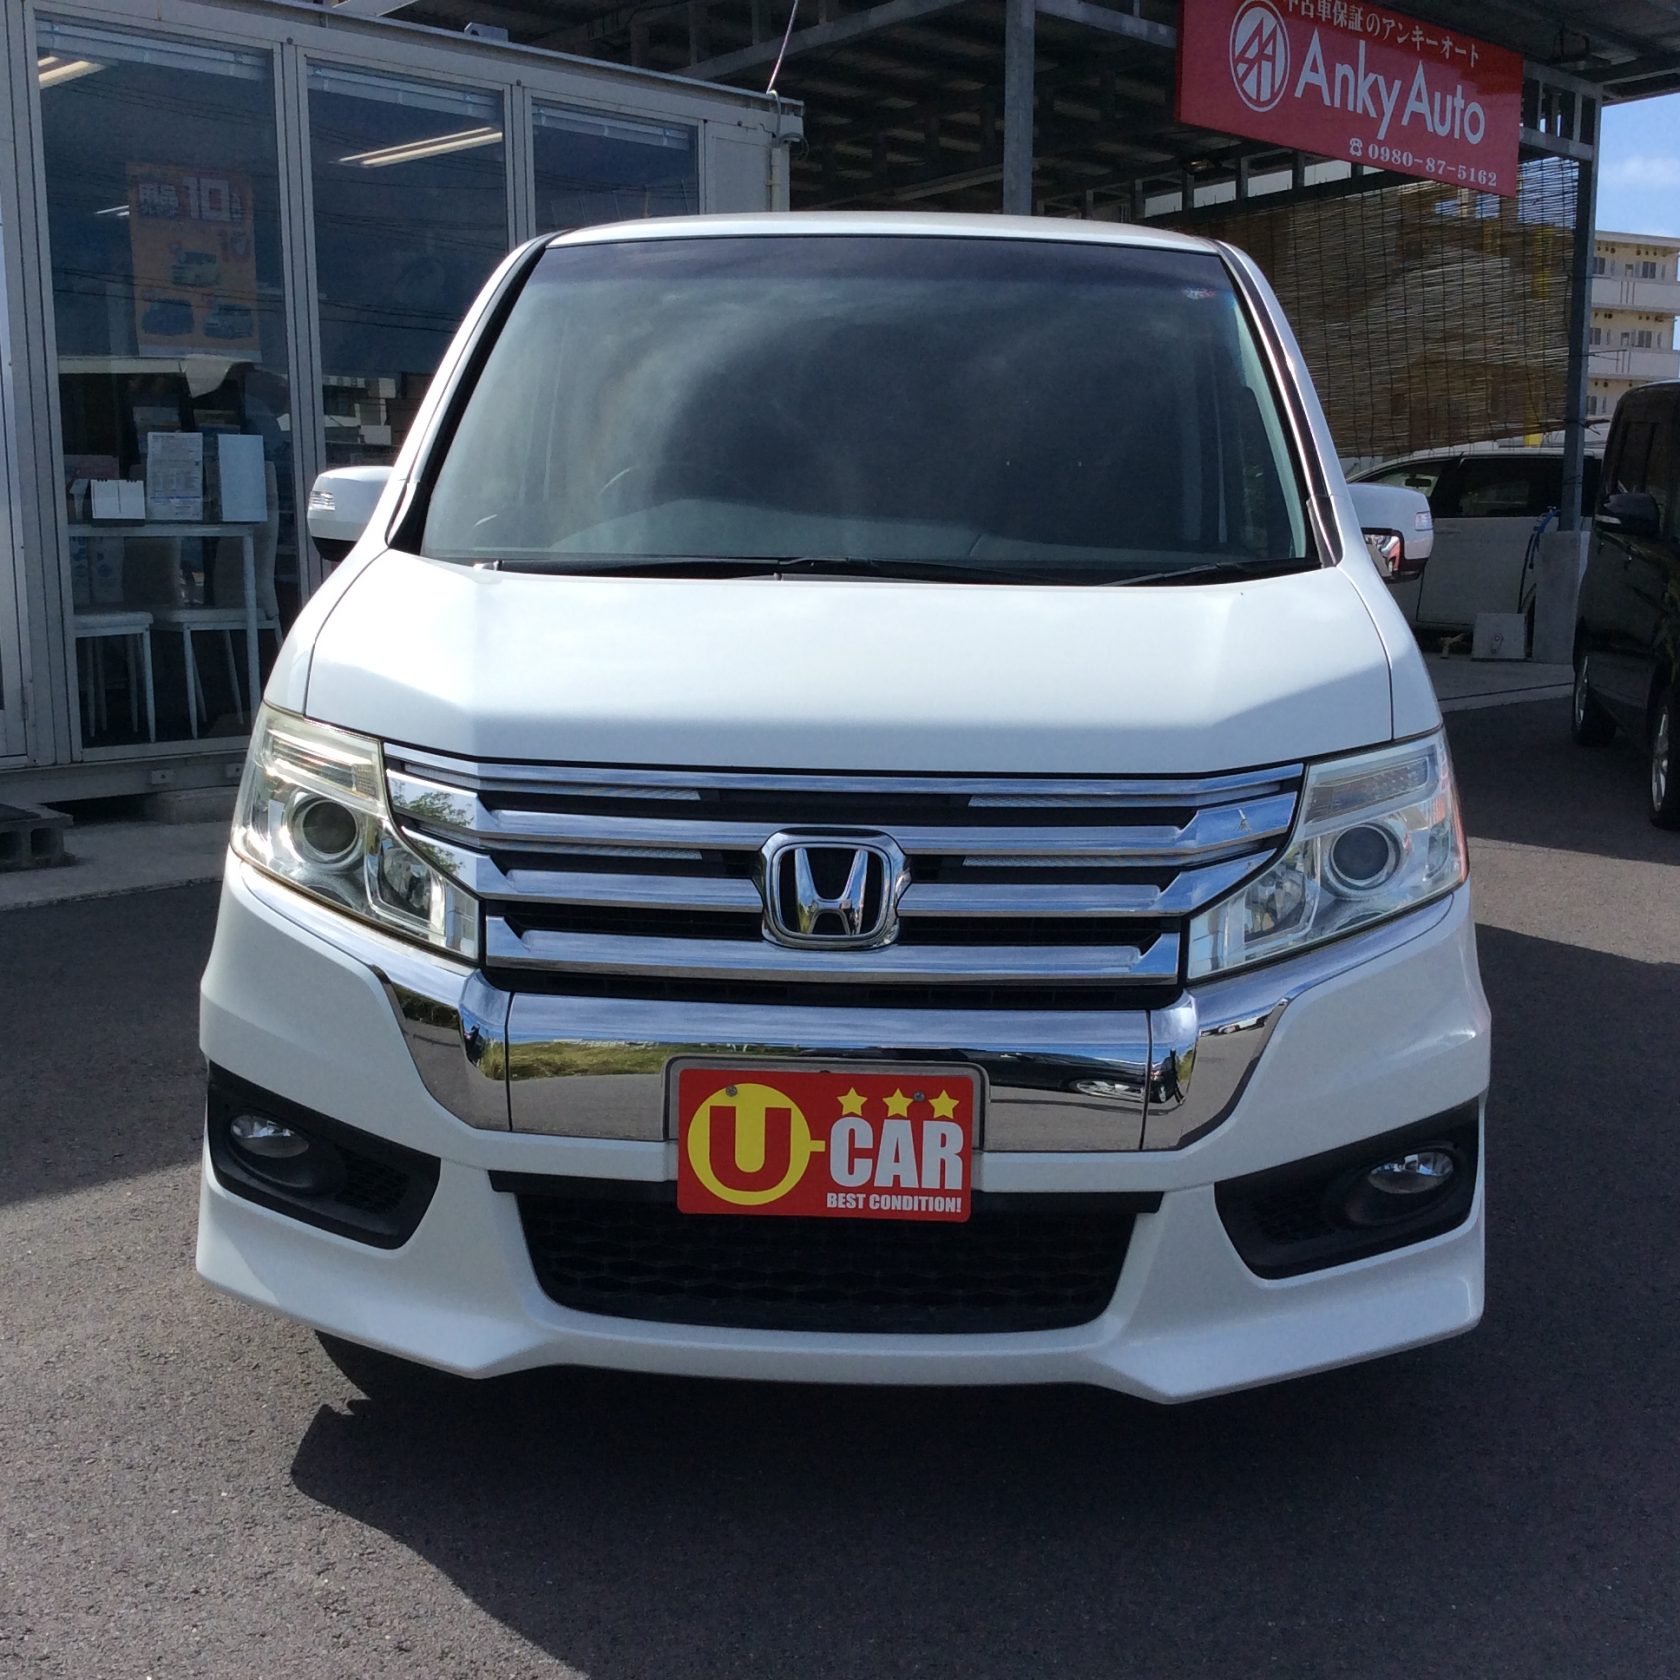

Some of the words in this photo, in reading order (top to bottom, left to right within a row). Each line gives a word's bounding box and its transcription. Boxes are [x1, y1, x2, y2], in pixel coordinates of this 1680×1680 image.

[1294, 26, 1402, 141] Anky
[1401, 59, 1486, 145] Auto
[1368, 143, 1498, 188] 0980-87-5162
[826, 1192, 866, 1209] BEST
[869, 1193, 962, 1213] CONDITION!
